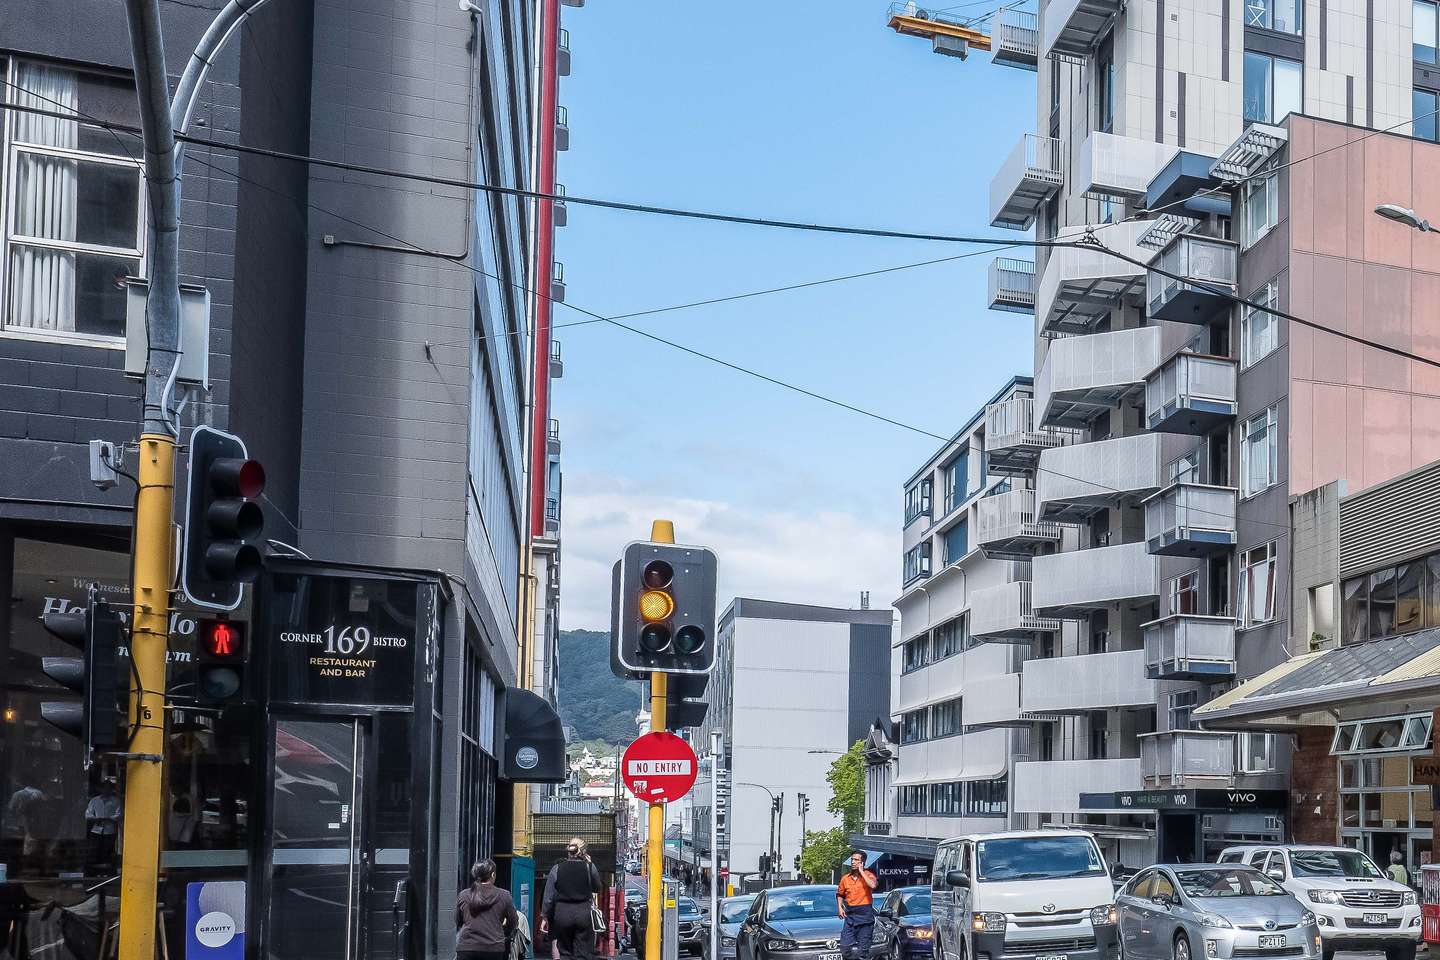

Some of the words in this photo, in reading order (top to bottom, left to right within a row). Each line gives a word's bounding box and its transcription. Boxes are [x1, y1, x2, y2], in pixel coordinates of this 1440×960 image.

[280, 632, 323, 643] CORNER
[323, 625, 370, 655] 169
[373, 637, 407, 648] BISTRO
[309, 657, 377, 668] RESTAURANT
[320, 668, 342, 677] AND
[345, 669, 366, 678] BAR
[144, 709, 152, 720] 6
[637, 762, 648, 773] NO
[655, 762, 682, 773] ENTRY
[1174, 794, 1187, 805] VIVO
[1227, 792, 1256, 803] VIVO
